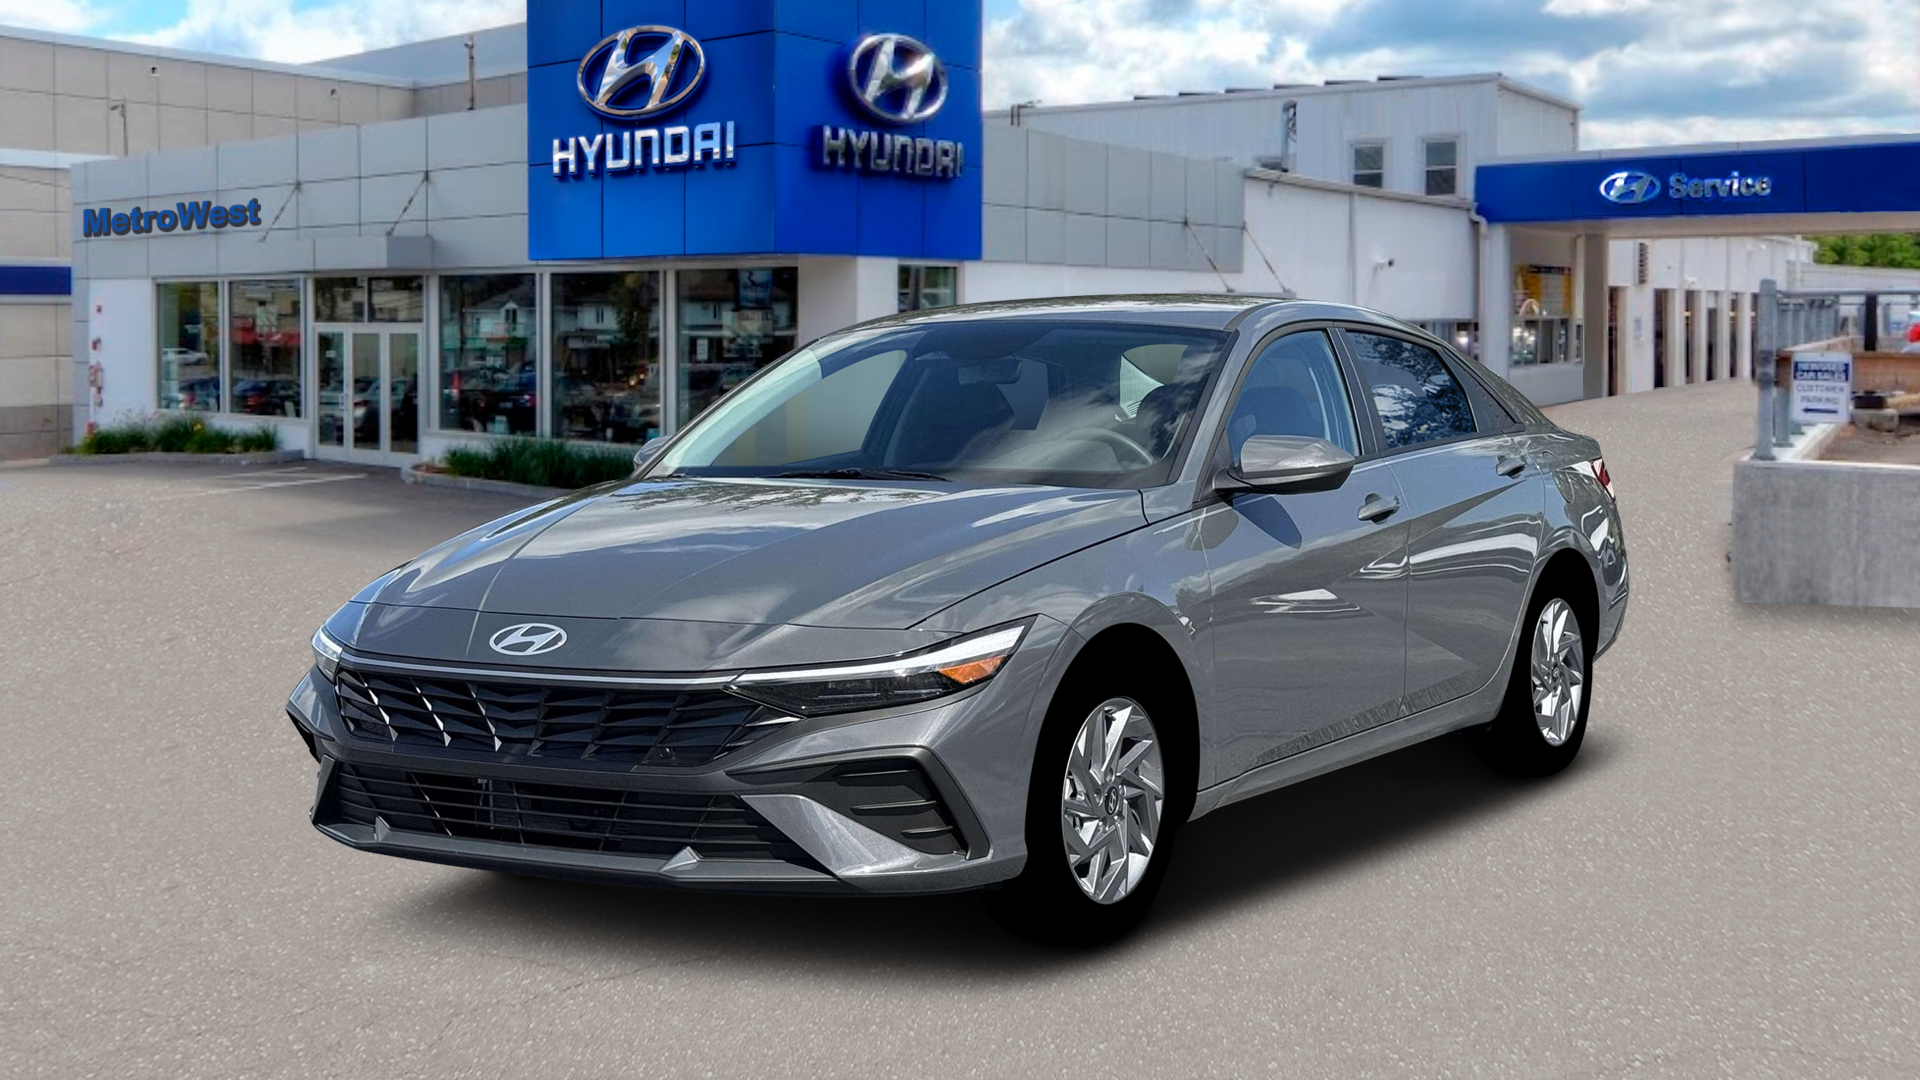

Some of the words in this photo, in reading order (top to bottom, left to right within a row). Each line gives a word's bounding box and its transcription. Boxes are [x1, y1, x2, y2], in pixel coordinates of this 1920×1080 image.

[552, 121, 736, 178] HYUNDAI
[822, 125, 965, 179] HYUNDAI
[1668, 170, 1772, 199] Service
[83, 198, 262, 238] MetroWest
[1796, 384, 1844, 393] CUSTOMER
